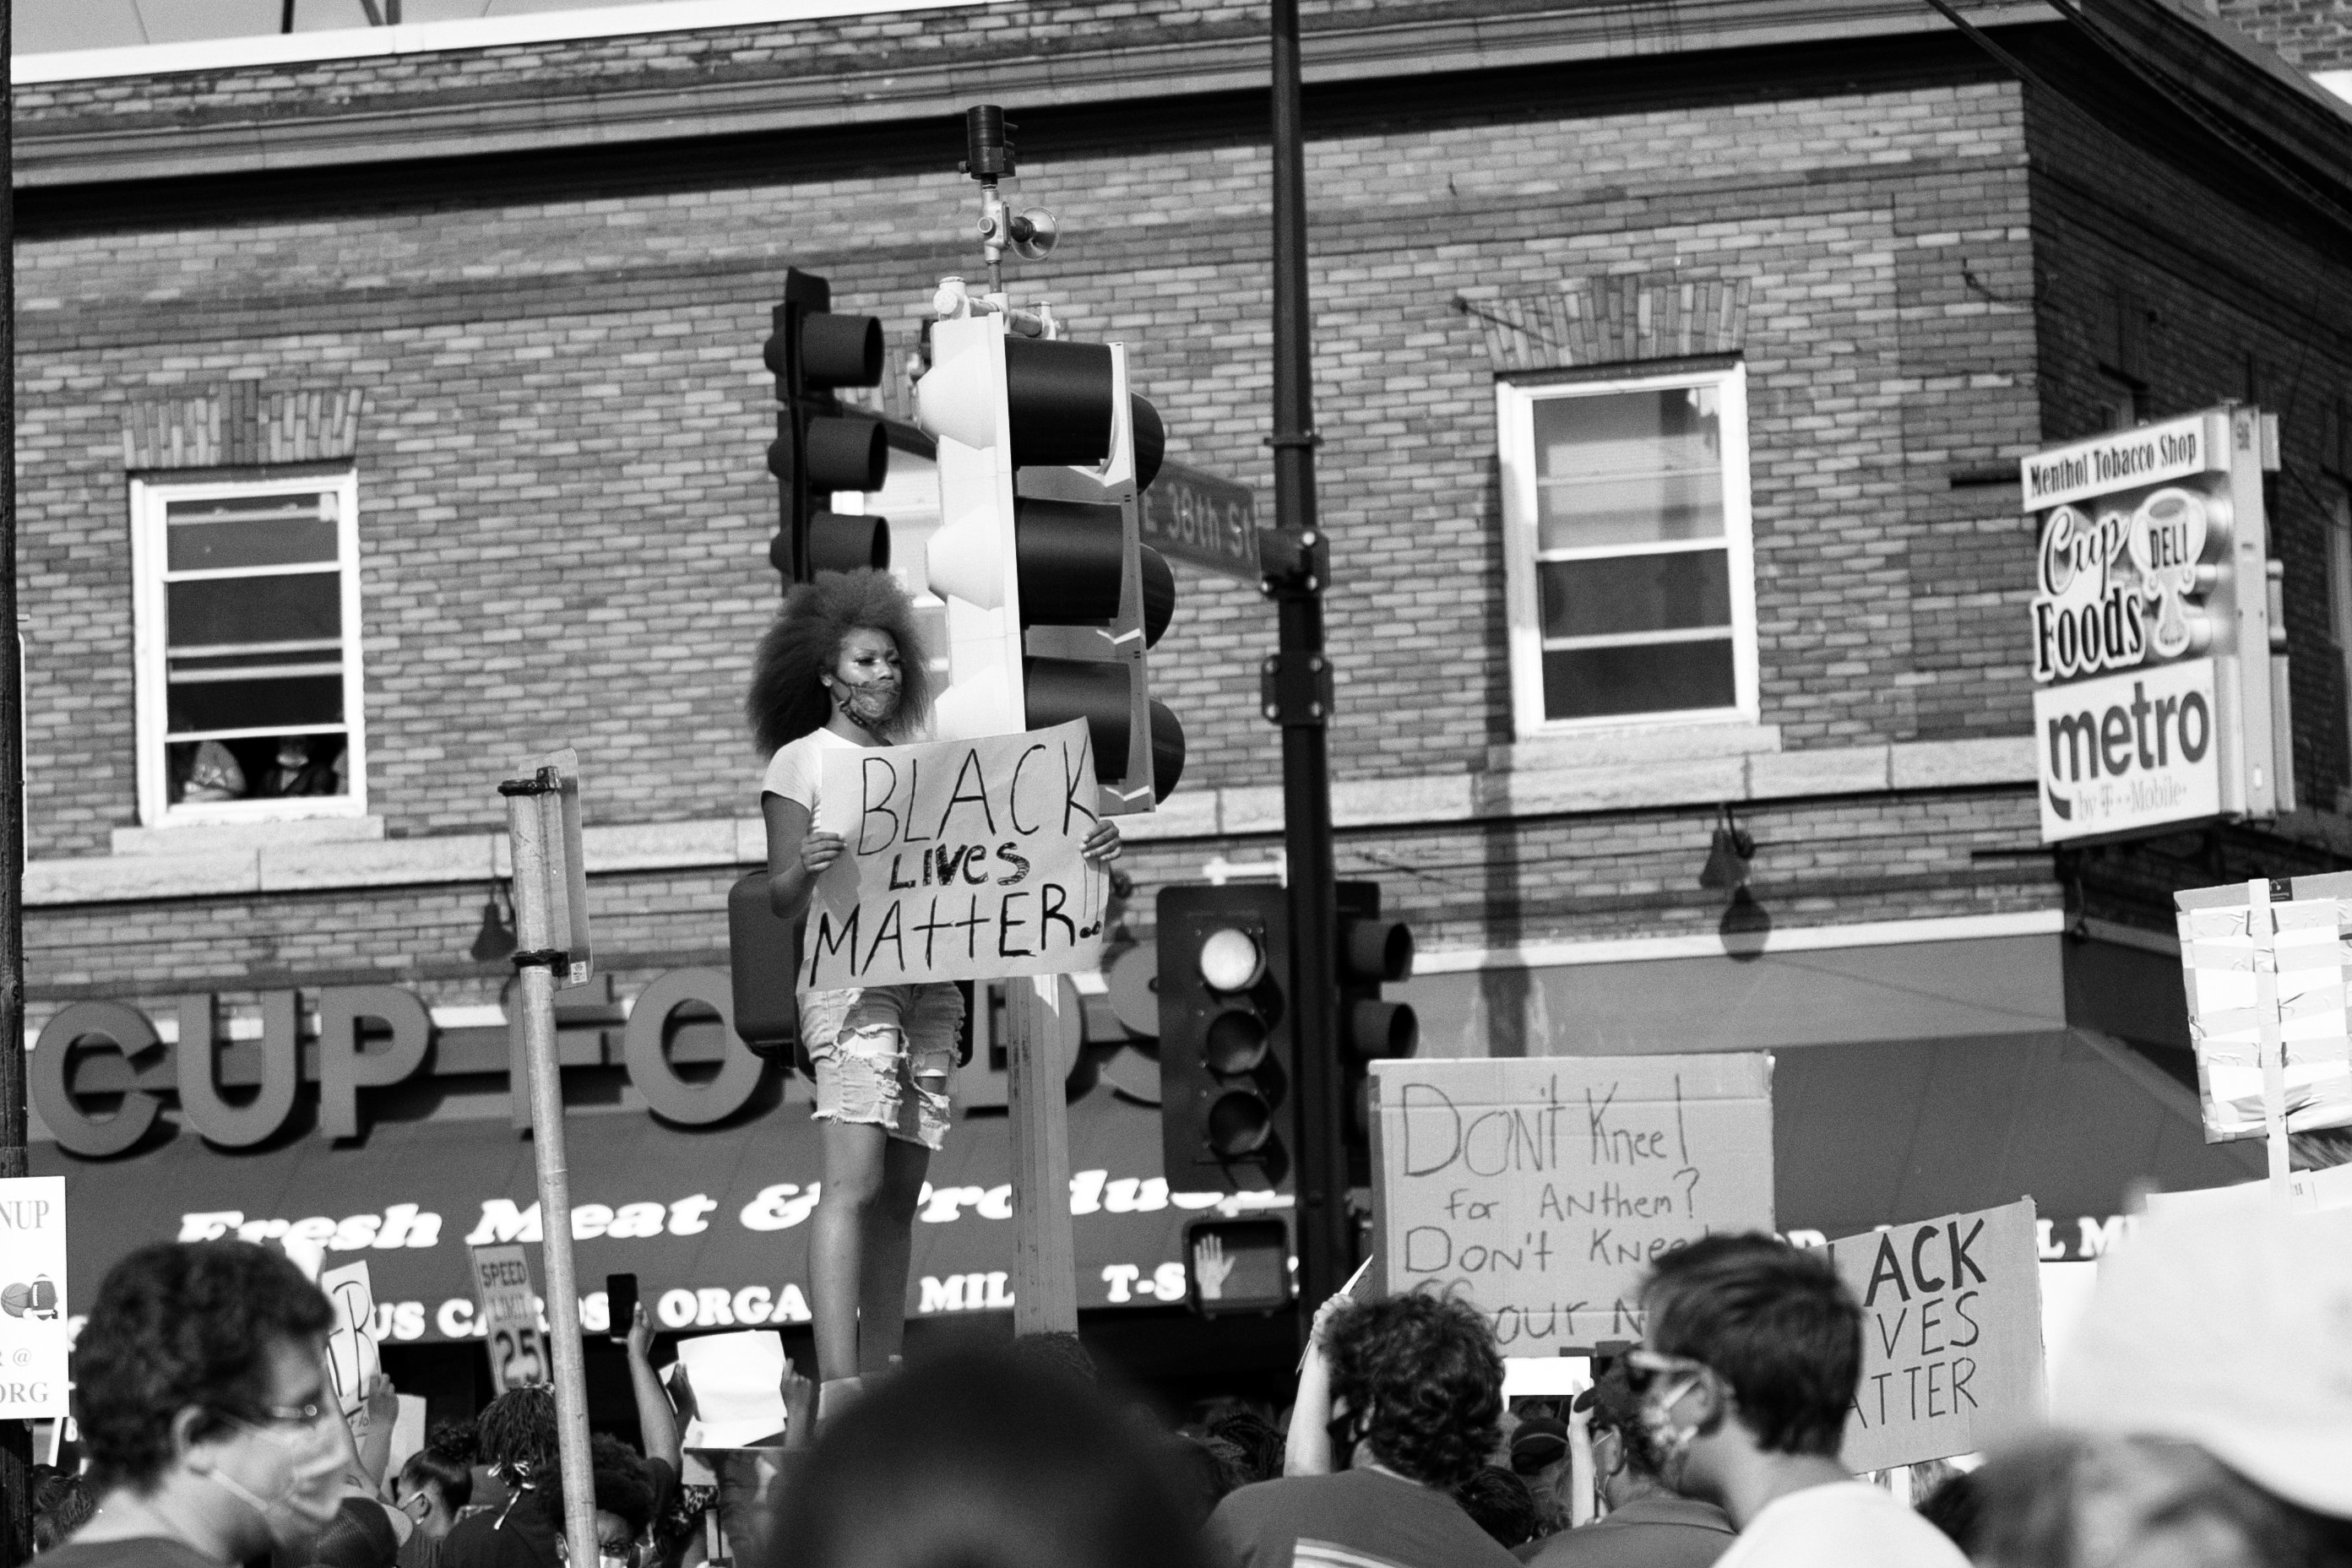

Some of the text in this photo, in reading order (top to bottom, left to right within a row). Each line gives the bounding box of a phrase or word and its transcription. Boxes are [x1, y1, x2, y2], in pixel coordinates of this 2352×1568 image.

[2030, 455, 2089, 500] Menthol
[2094, 442, 2155, 482] Tobacco
[2159, 431, 2197, 468] Shop
[1166, 481, 1222, 551] 38th
[1229, 499, 1254, 562] St
[2045, 510, 2122, 601] Cup
[2150, 524, 2189, 570] DELI
[2037, 588, 2143, 672] Foods
[2048, 681, 2211, 782] metro
[858, 735, 1099, 856] BLACK
[32, 984, 431, 1156] CUP
[0, 1199, 50, 1234] NUP
[1445, 1188, 1499, 1220] for
[481, 1259, 527, 1288] SPEED
[920, 1272, 1014, 1313] MIL
[1828, 1218, 1986, 1307] ACK
[496, 1327, 541, 1386] 25
[1494, 1301, 1589, 1344] our
[1876, 1290, 1980, 1360] VES
